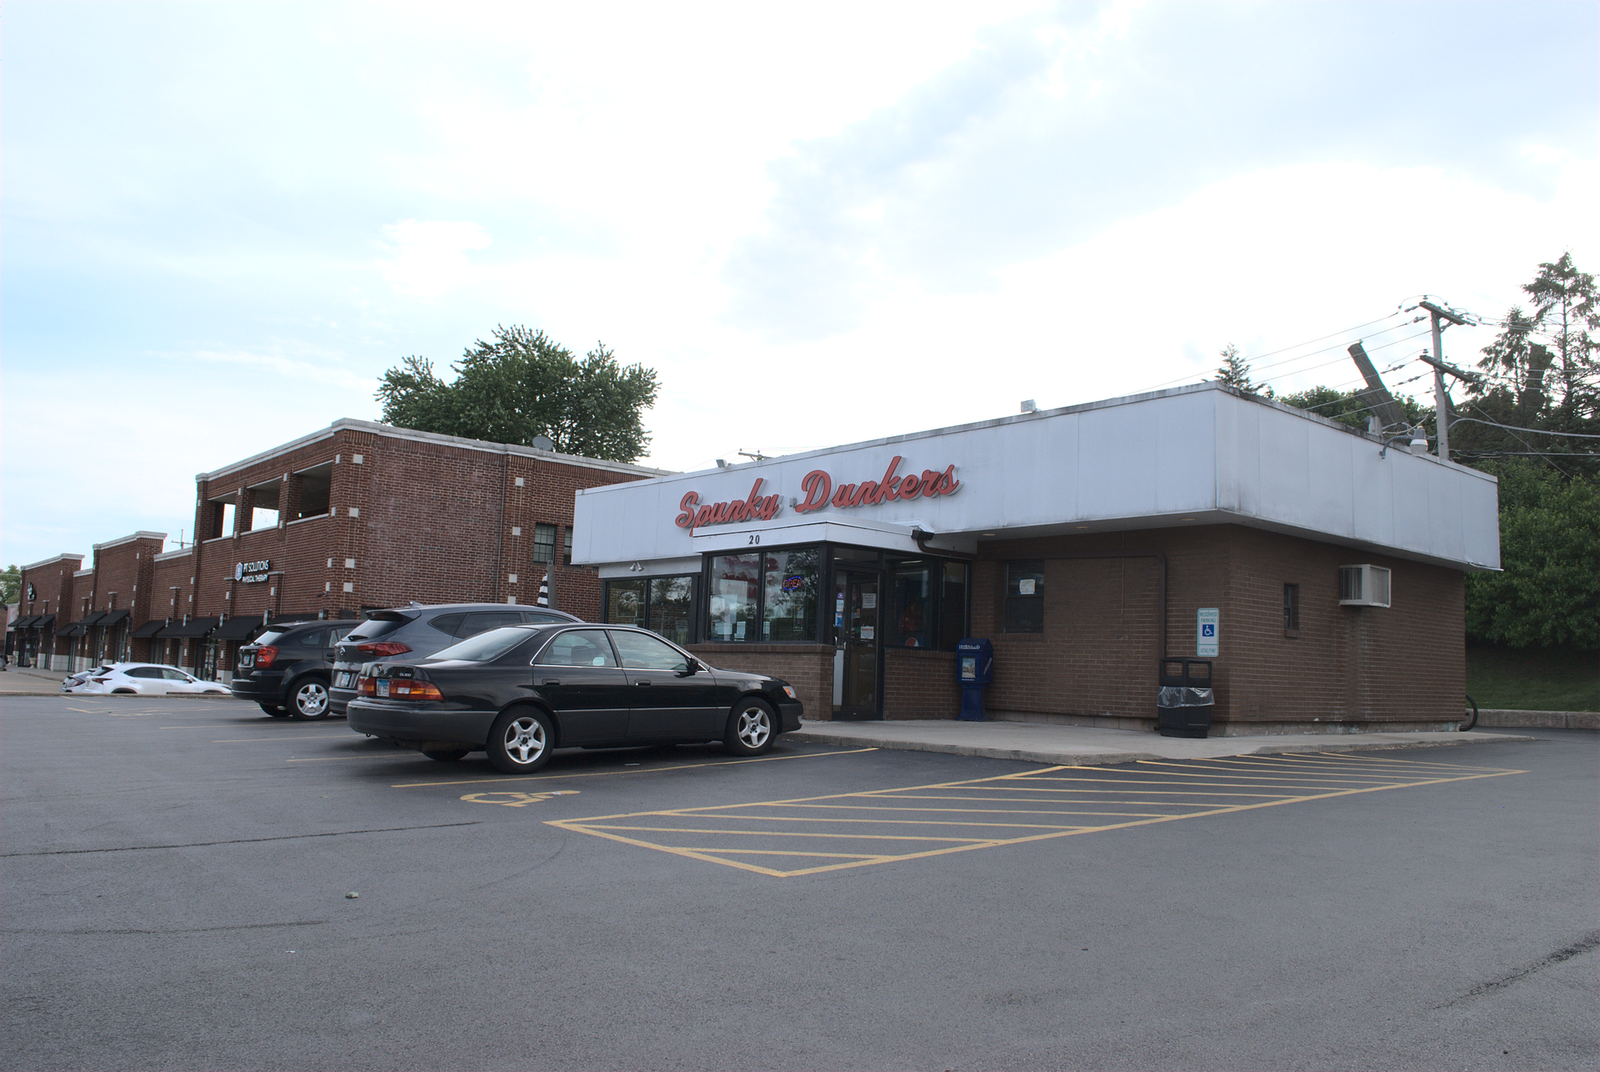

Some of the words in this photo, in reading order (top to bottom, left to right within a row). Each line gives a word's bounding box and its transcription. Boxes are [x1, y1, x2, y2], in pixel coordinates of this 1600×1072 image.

[675, 478, 780, 537] Spunky
[795, 456, 959, 513] Dunkers
[748, 534, 760, 544] 20
[248, 560, 269, 572] SOLUTIONS
[782, 578, 802, 588] OPEN
